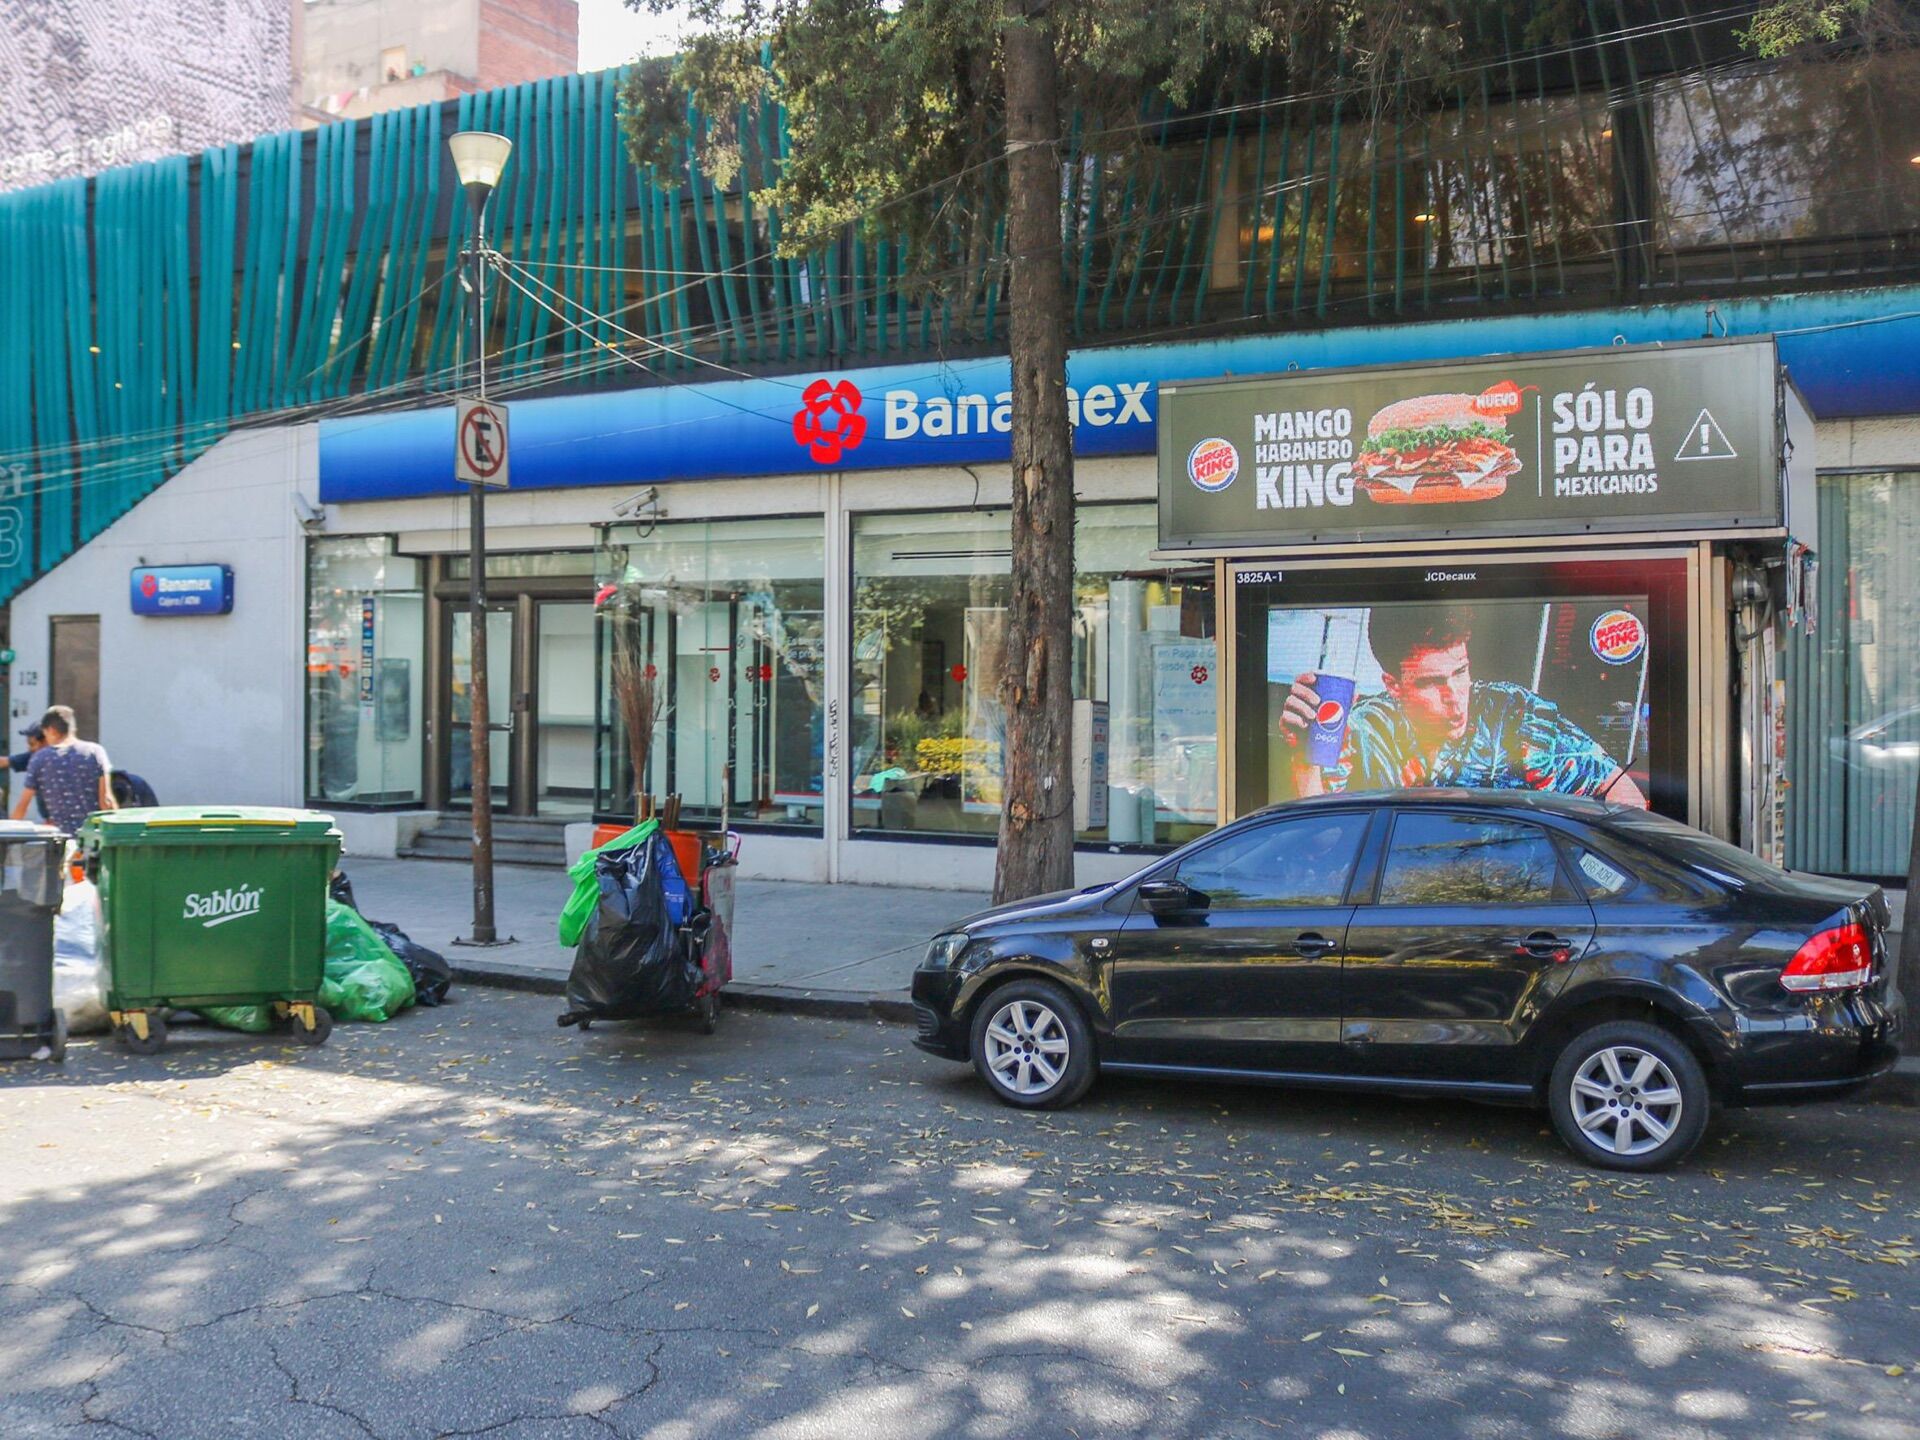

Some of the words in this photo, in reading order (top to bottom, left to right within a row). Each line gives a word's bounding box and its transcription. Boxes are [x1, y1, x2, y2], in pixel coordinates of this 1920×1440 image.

[885, 381, 1152, 439] Banaex
[1477, 391, 1518, 409] NUEVO
[1553, 382, 1653, 433] SÓLO
[1254, 408, 1352, 441] MANGO
[1194, 446, 1232, 468] BURGER
[1255, 439, 1353, 463] HABANERO
[1554, 432, 1655, 473] PARA
[1196, 456, 1233, 480] KING
[1256, 461, 1355, 509] KING
[1554, 474, 1658, 497] MEXICANOS
[1237, 572, 1284, 584] 3825A-1
[1424, 571, 1477, 582] JCDecaux
[1597, 619, 1637, 640] BURGER
[1599, 630, 1639, 653] KING
[183, 883, 261, 920] Sablón
